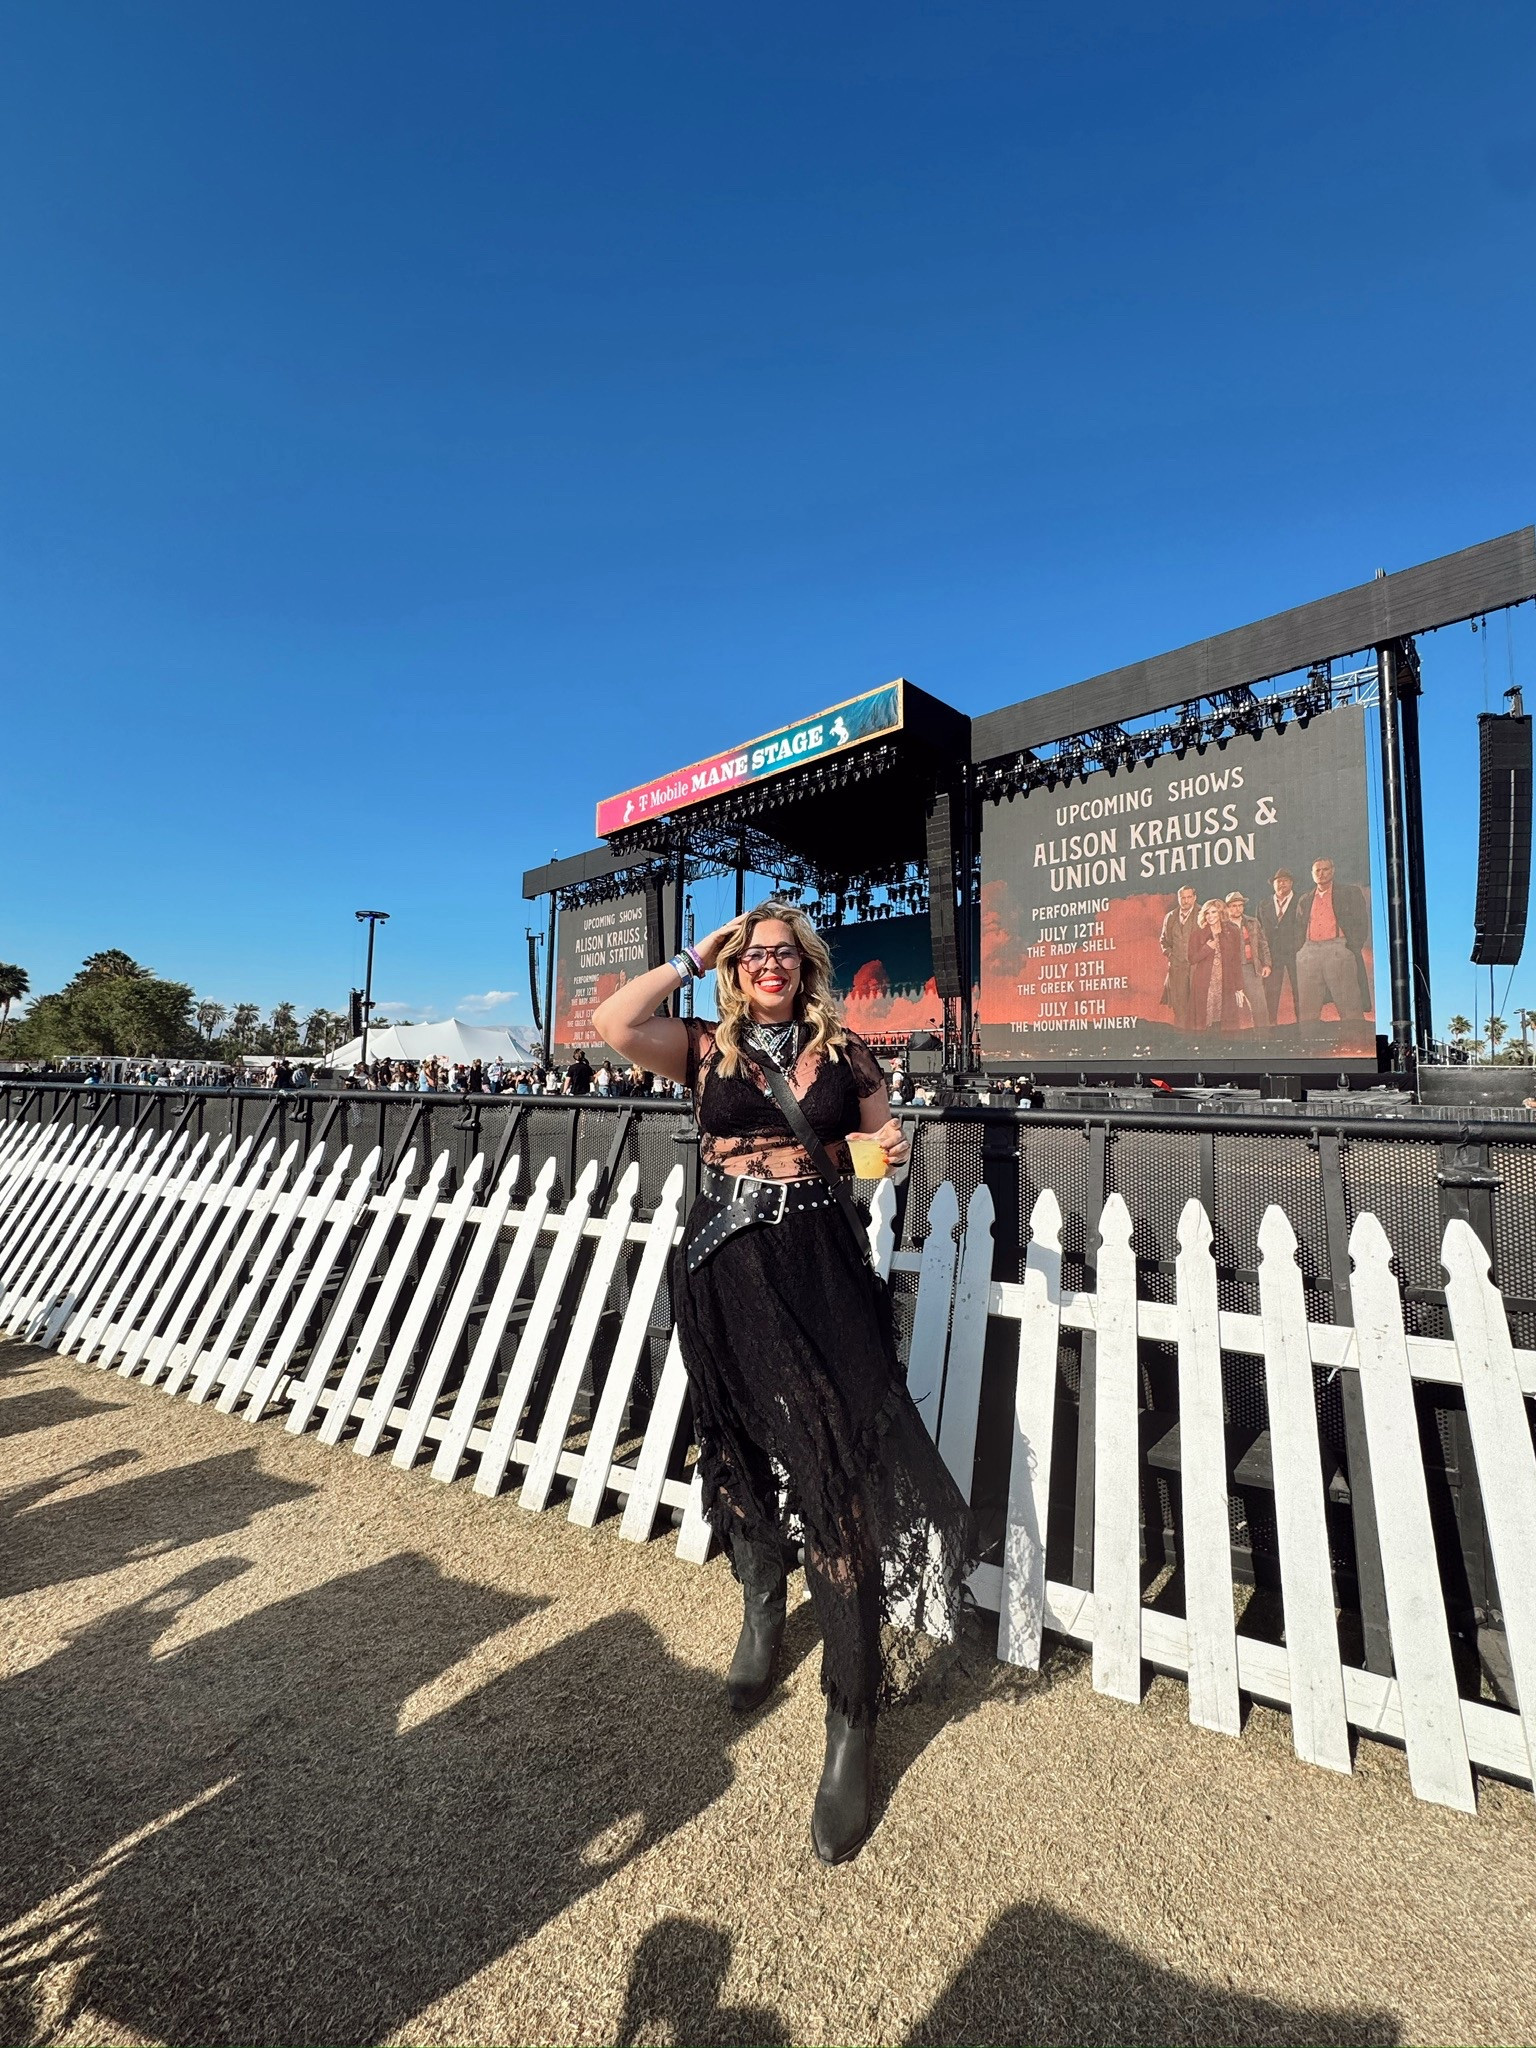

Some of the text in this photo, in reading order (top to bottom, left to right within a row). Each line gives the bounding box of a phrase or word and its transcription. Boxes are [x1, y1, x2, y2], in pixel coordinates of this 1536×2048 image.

[650, 782, 688, 805] Mobile
[691, 754, 748, 793] MANE
[751, 725, 823, 771] STAGE
[1056, 766, 1244, 827] UPCOMING SHOWS
[1033, 796, 1278, 868] ALISON KRAUSS &
[1050, 833, 1255, 892] UNION STATION
[584, 908, 642, 930] UPCOMING SHOWS
[1032, 897, 1110, 921] PERFORMING
[575, 935, 604, 953] ALISON
[607, 929, 639, 948] KRAUSS
[1037, 921, 1105, 944] JULY 12TH
[580, 944, 644, 969] UNION STATION
[1027, 938, 1116, 958] THE RADY SHELL
[573, 974, 599, 984] PERFORMING
[1037, 960, 1105, 981] JULY 13TH
[1017, 976, 1128, 995] THE GREEK THEATRE
[1037, 999, 1105, 1018] JULY 16TH
[1010, 1016, 1138, 1033] THE MOUNTAIN WINERY
